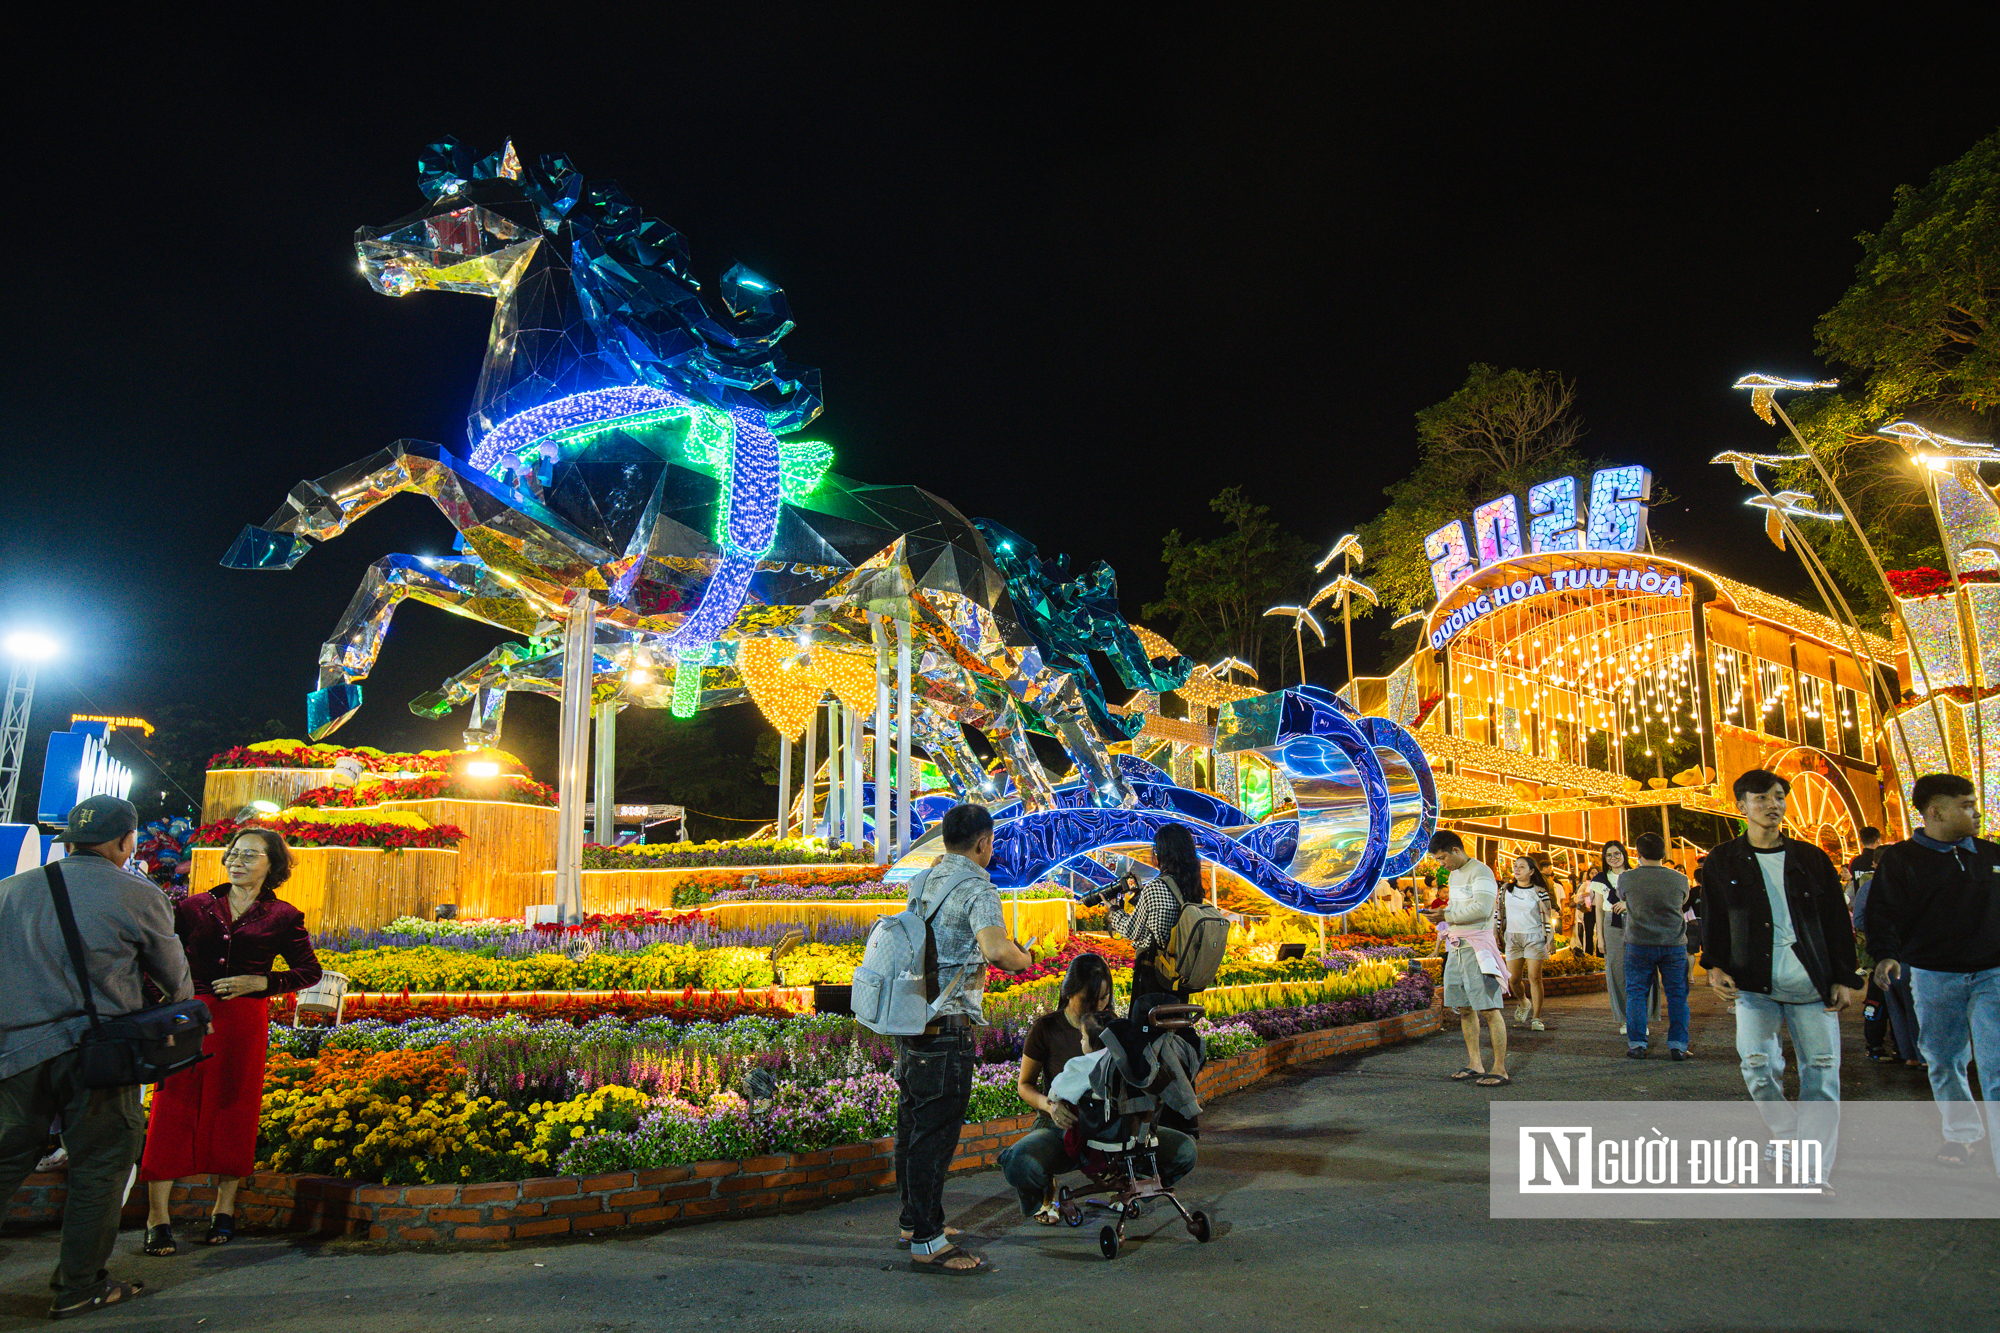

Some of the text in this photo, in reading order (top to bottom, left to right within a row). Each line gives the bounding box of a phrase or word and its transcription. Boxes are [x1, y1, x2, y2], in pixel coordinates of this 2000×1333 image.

[1424, 464, 1647, 602] 2026
[1431, 565, 1682, 649] ĐƯỜNG HOA TUY HÒA
[620, 805, 649, 816] 2026
